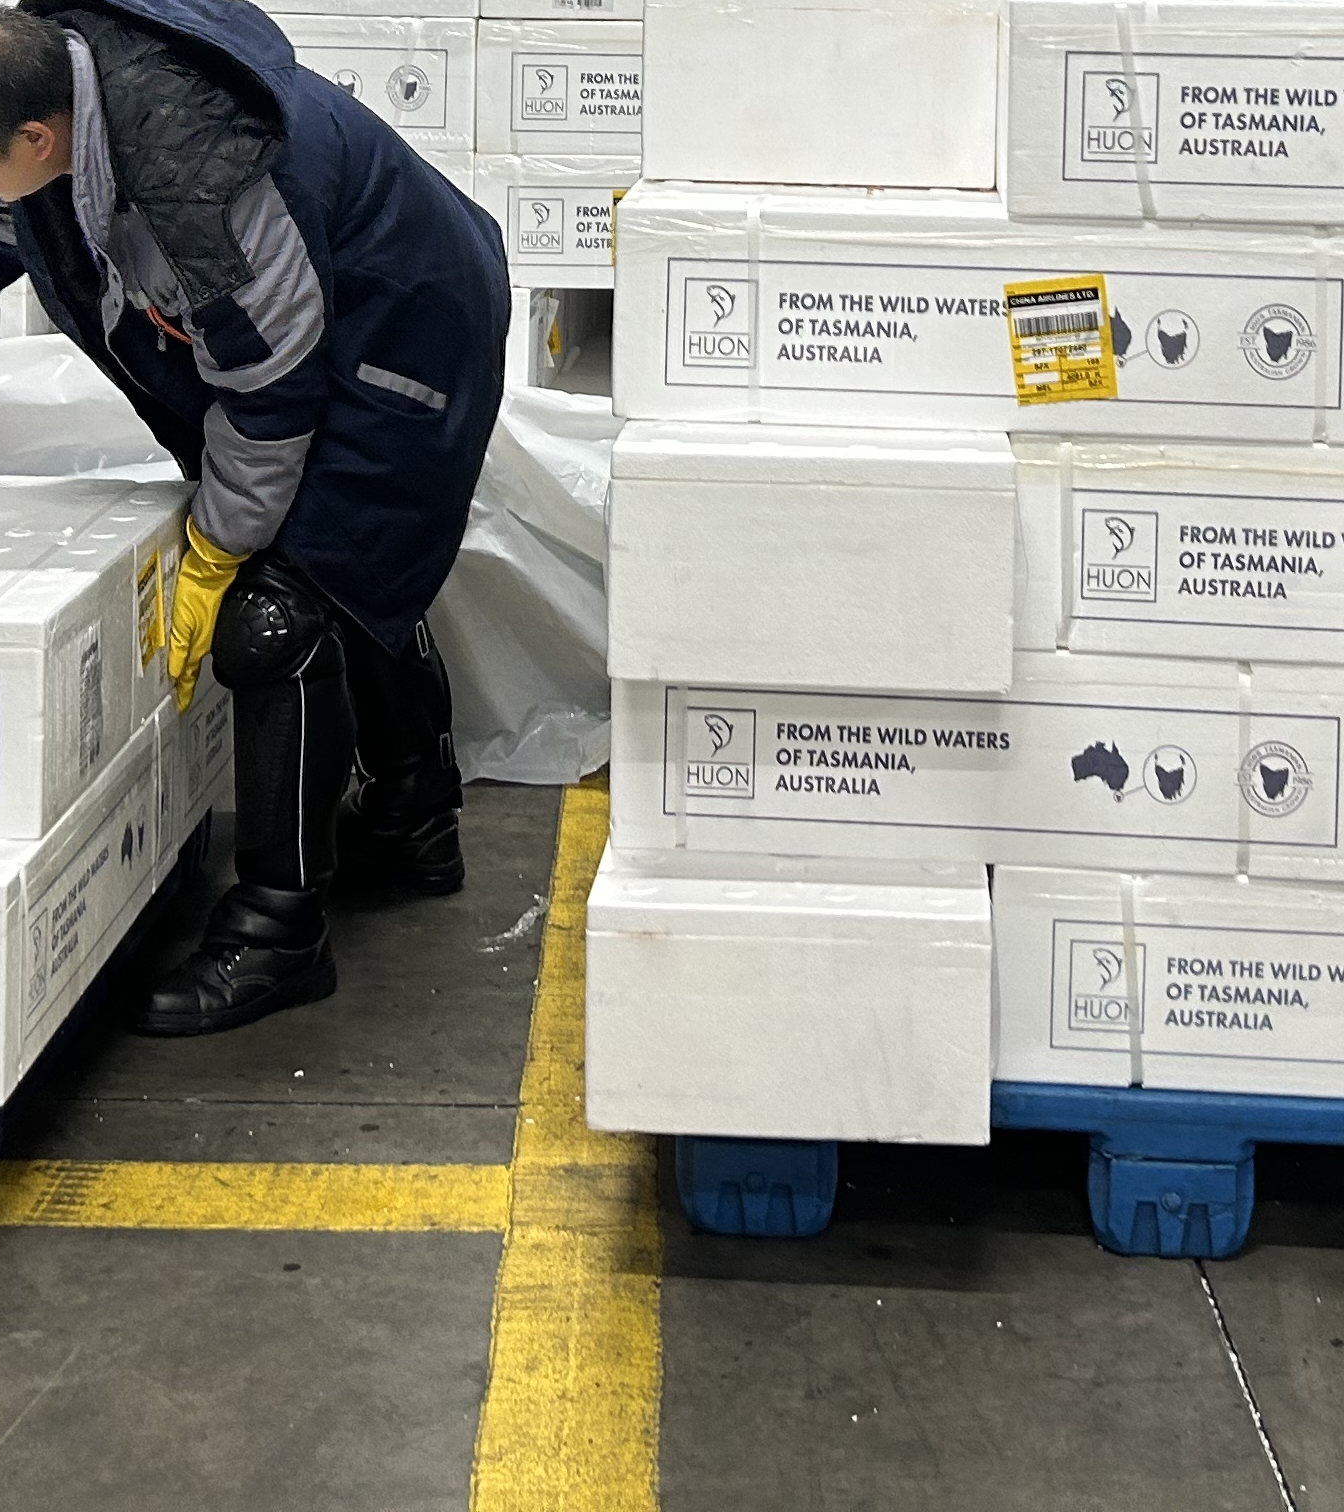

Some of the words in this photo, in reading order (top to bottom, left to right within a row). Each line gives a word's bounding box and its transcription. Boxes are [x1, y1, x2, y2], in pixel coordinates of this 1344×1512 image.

[580, 72, 614, 84] FROM
[617, 73, 639, 84] THE
[525, 100, 564, 112] HUON
[580, 88, 596, 100] OF
[598, 89, 640, 103] TASMA
[1180, 86, 1238, 105] FROM
[1243, 87, 1279, 106] THE
[1285, 88, 1338, 107] WILD
[579, 104, 642, 116] AUSTRALIA
[1180, 112, 1207, 130] OF
[1212, 112, 1325, 136] TASMANIA,
[1087, 130, 1152, 151] HUON
[1178, 138, 1289, 158] AUSTRALIA
[778, 292, 834, 311] FROM
[839, 294, 873, 312] THE
[879, 295, 930, 314] WILD
[935, 297, 1008, 317] WATERS
[778, 318, 804, 336] OF
[808, 319, 918, 343] TASMANIA,
[688, 335, 751, 356] HUON
[776, 344, 883, 364] AUSTRALIA
[1179, 525, 1236, 545] FROM
[1242, 528, 1278, 547] THE
[1284, 530, 1336, 550] WILD
[1179, 551, 1206, 570] OF
[1210, 552, 1323, 578] TASMANIA,
[1086, 567, 1151, 589] HUON
[1177, 577, 1287, 599] AUSTRALIA
[776, 722, 832, 742] FROM
[836, 725, 871, 744] THE
[877, 727, 928, 746] WILD
[933, 729, 1011, 750] WATERS
[776, 748, 802, 767] OF
[806, 749, 916, 775] TASMANIA,
[687, 764, 749, 786] HUON
[775, 774, 881, 796] AUSTRALIA
[1166, 957, 1223, 977] FROM
[1228, 960, 1264, 979] THE
[1270, 962, 1322, 982] WILD
[1166, 982, 1193, 1001] OF
[1197, 984, 1309, 1010] TASMANIA,
[1164, 1009, 1273, 1031] AUSTRALIA
